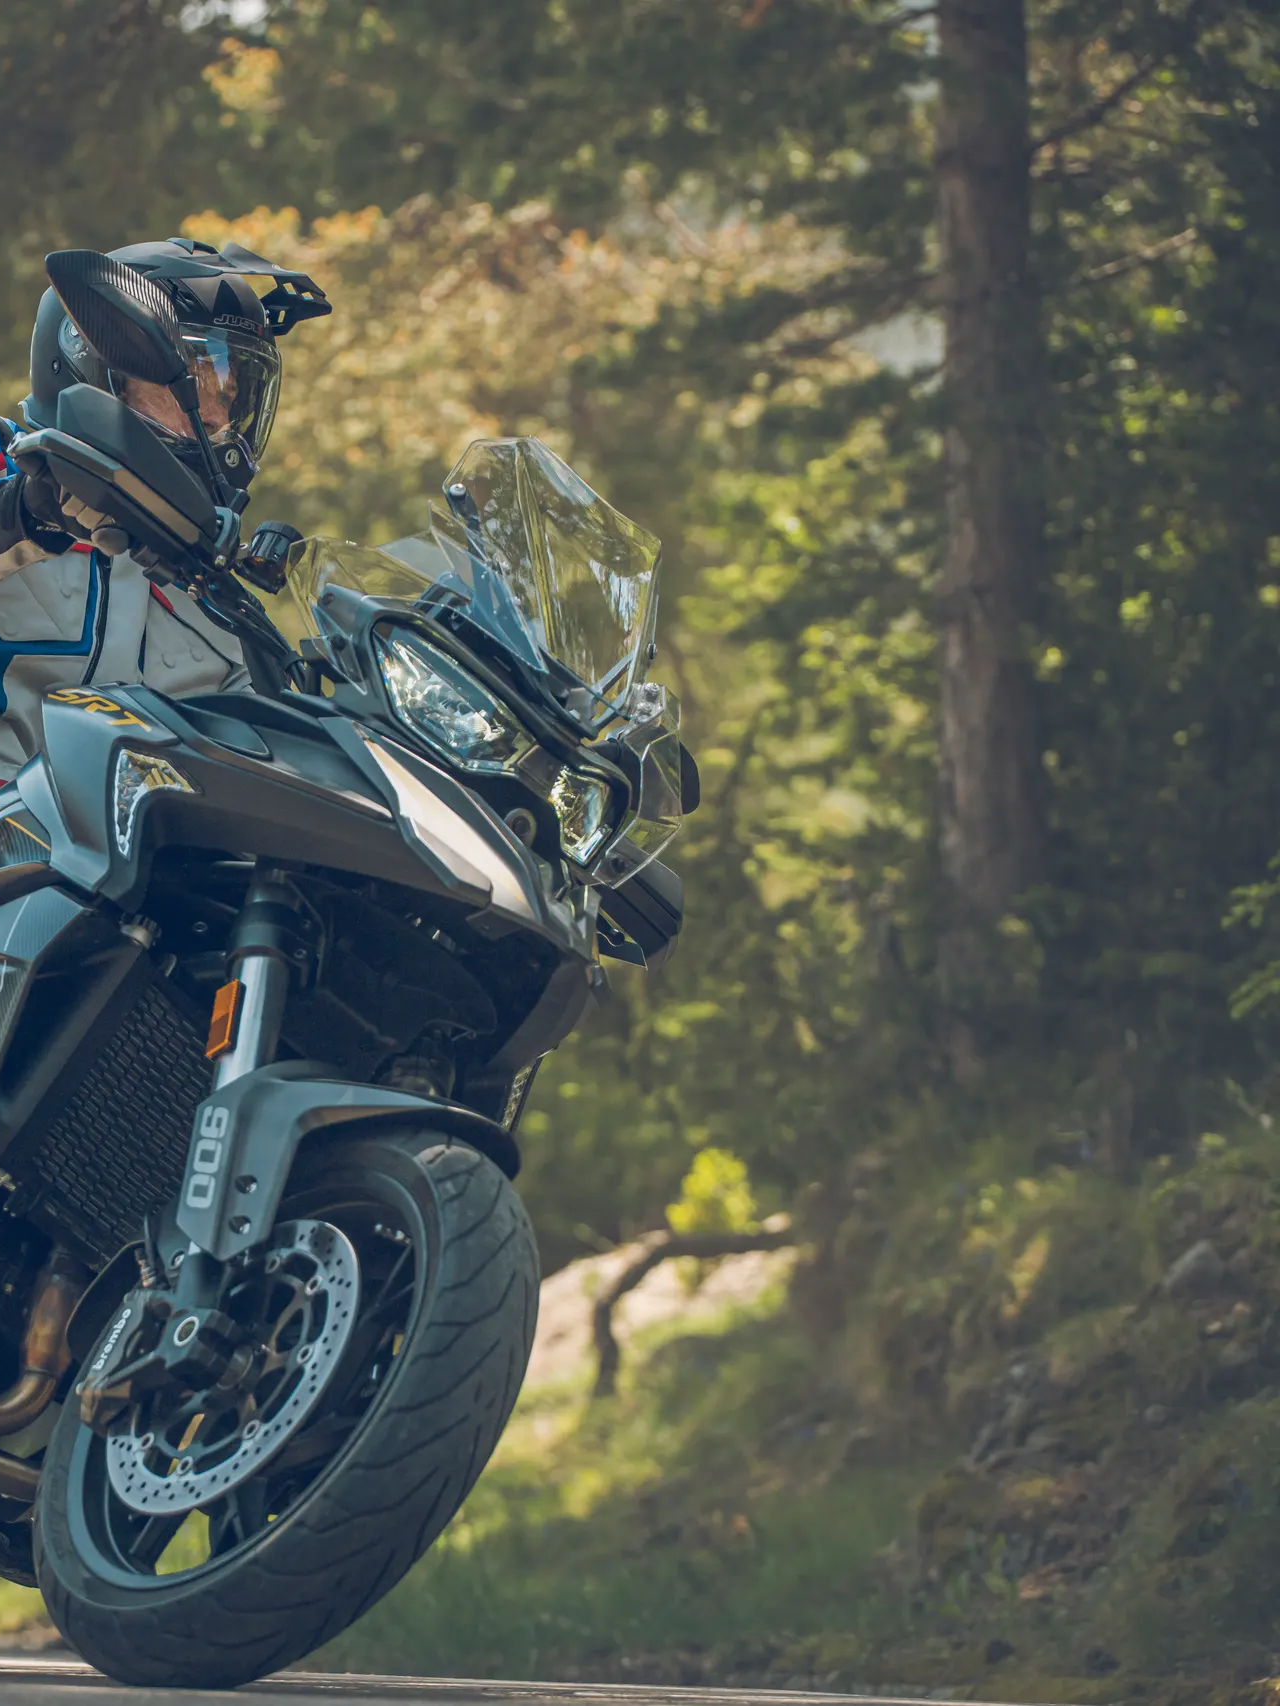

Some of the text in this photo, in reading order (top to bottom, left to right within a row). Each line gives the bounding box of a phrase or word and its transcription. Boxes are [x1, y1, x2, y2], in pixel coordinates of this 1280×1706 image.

[47, 688, 152, 733] SRT
[186, 1105, 230, 1209] 900
[91, 1308, 132, 1370] brembo
